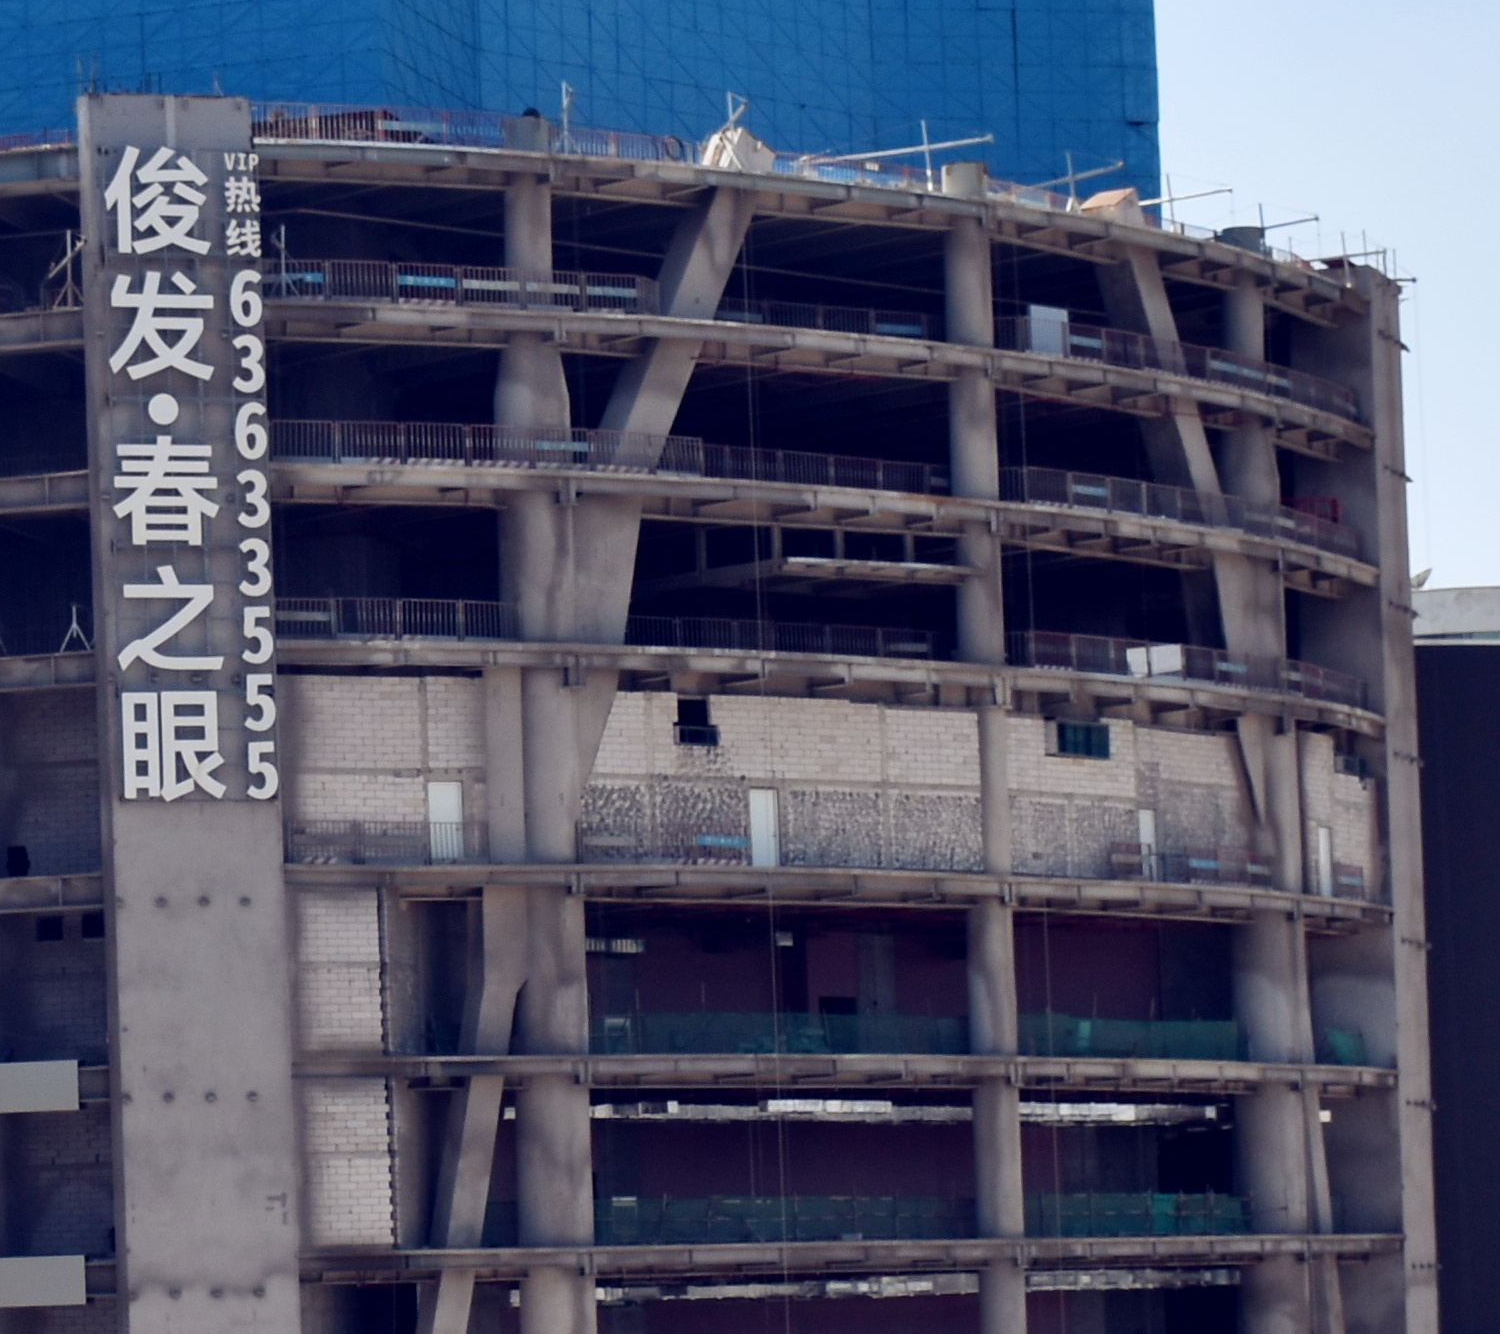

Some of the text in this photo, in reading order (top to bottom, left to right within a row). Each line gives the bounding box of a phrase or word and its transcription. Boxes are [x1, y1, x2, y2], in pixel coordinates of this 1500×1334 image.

[104, 145, 228, 803] 俊发·春之眼
[229, 269, 280, 801] 63633555
